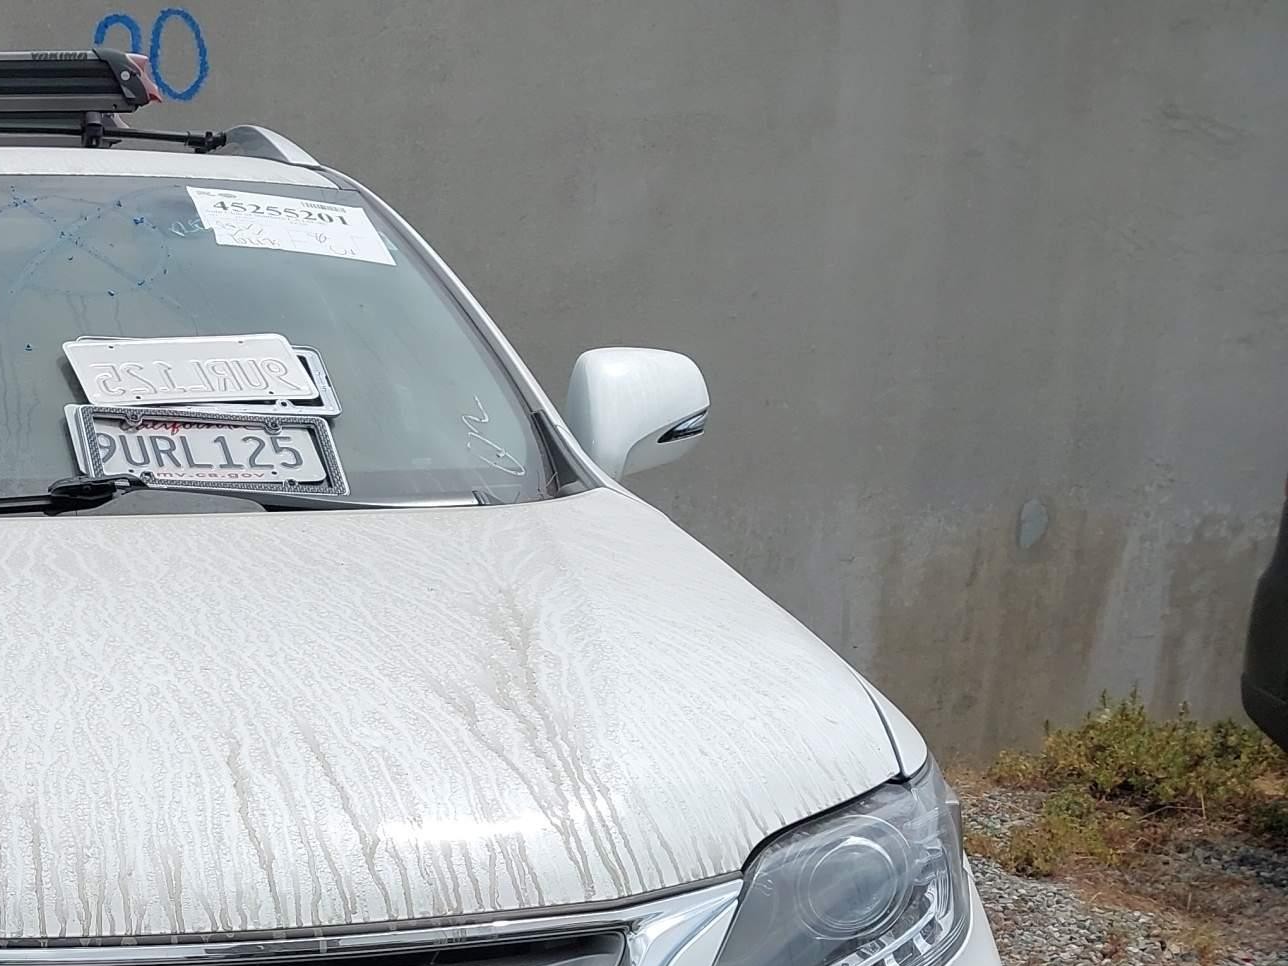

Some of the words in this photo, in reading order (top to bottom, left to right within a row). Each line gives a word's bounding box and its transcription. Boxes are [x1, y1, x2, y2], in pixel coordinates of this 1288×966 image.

[213, 199, 350, 226] 45255201
[97, 433, 304, 469] 9URL125
[156, 471, 266, 480] mv.ca.gov
